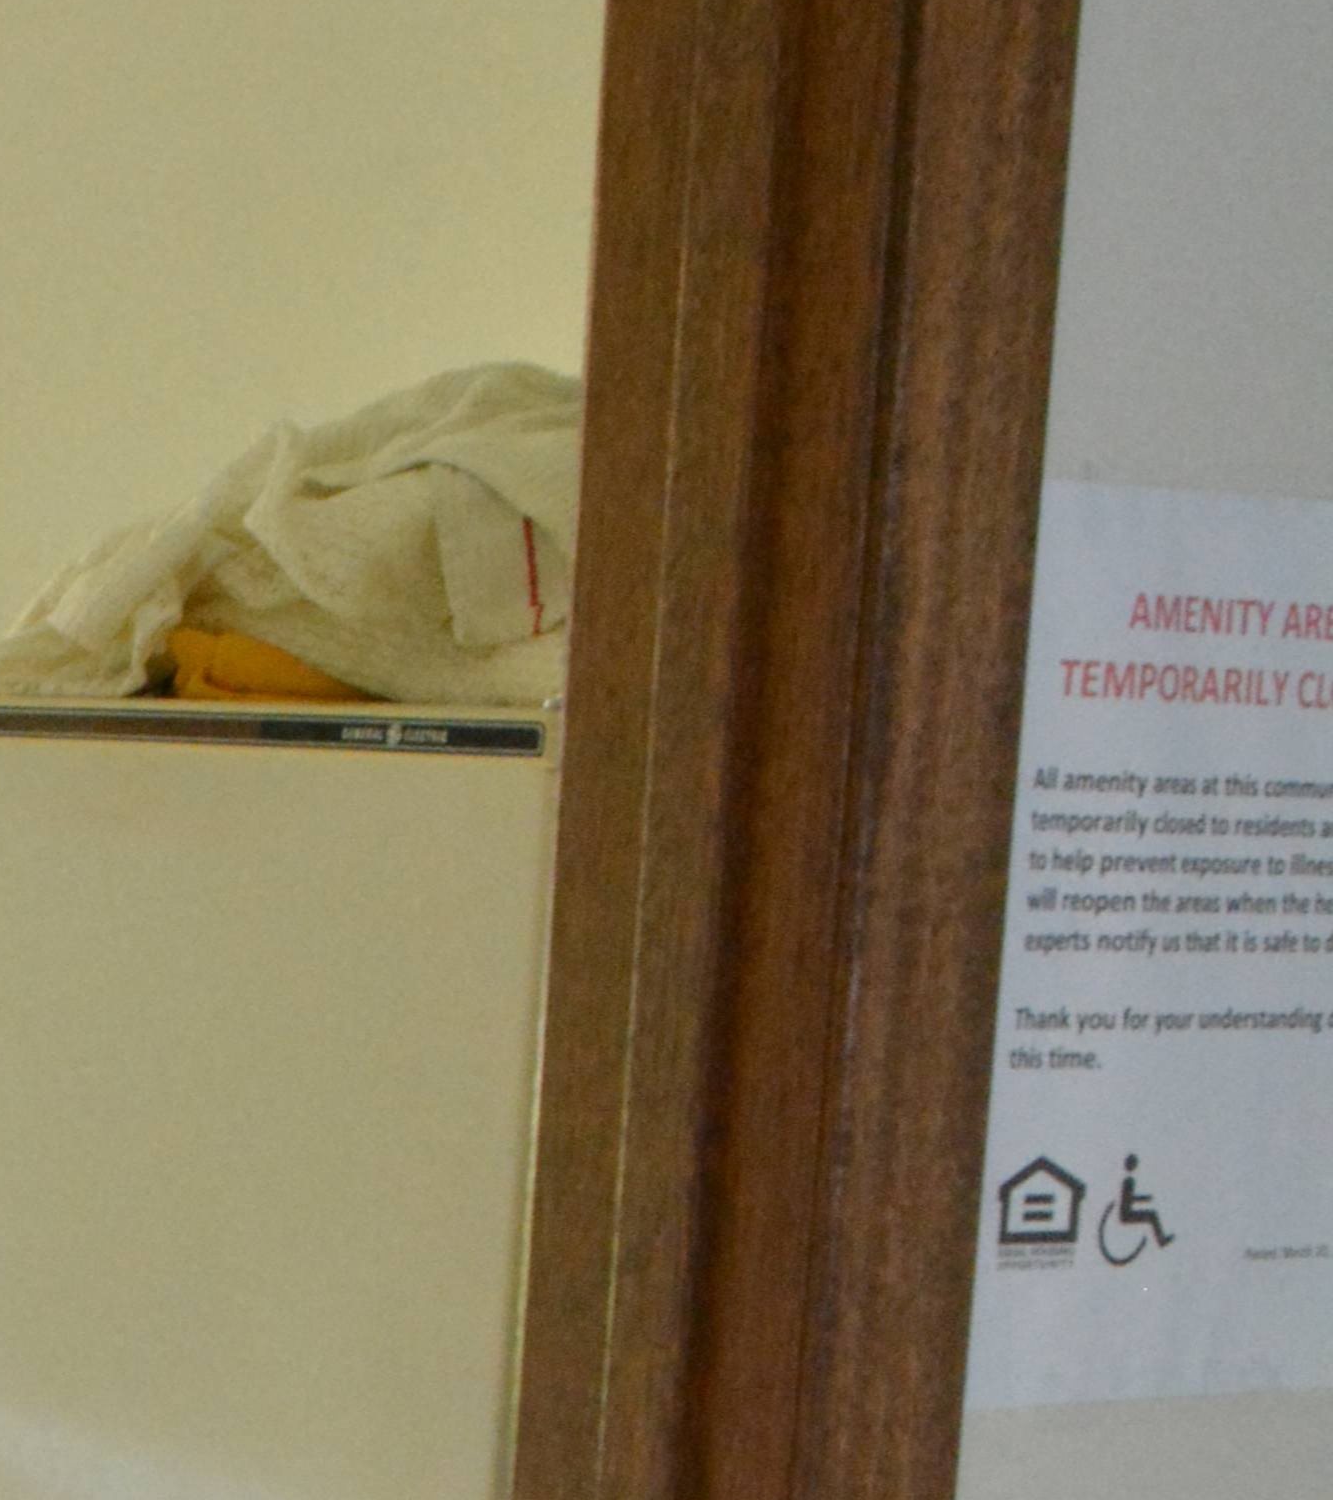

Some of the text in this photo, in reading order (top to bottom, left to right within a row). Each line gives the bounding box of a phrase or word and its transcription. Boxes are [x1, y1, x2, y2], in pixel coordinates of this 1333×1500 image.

[1129, 592, 1275, 636] AMENITY
[1060, 658, 1289, 707] TEMPORARILY
[1034, 767, 1058, 789] All
[1063, 770, 1148, 798] amenity
[1153, 775, 1197, 796] areas
[1201, 775, 1219, 796] at
[1224, 773, 1258, 797] this
[1032, 810, 1148, 838] temporarily
[1153, 811, 1205, 835] closed
[1210, 815, 1229, 834] to
[1235, 813, 1316, 837] residents
[1030, 851, 1048, 871] to
[1051, 849, 1094, 875] help
[1100, 853, 1177, 876] prevent
[1181, 856, 1261, 878] exposure
[1267, 855, 1285, 876] to
[1027, 886, 1057, 911] will
[1062, 891, 1136, 916] reopen
[1142, 888, 1170, 912] the
[1175, 893, 1220, 913] areas
[1227, 890, 1276, 913] when
[1282, 891, 1309, 914] the
[1024, 931, 1090, 954] experts
[1097, 929, 1156, 956] notify
[1162, 934, 1181, 952] us
[1185, 931, 1220, 953] that
[1225, 930, 1238, 953] it
[1244, 930, 1257, 953] is
[1263, 930, 1298, 953] safe
[1303, 932, 1321, 953] to
[1015, 1006, 1070, 1030] Thank
[1076, 1012, 1116, 1034] you
[1122, 1007, 1149, 1030] for
[1153, 1012, 1192, 1034] your
[1198, 1006, 1322, 1035] understanding
[1009, 1047, 1103, 1070] this time.
